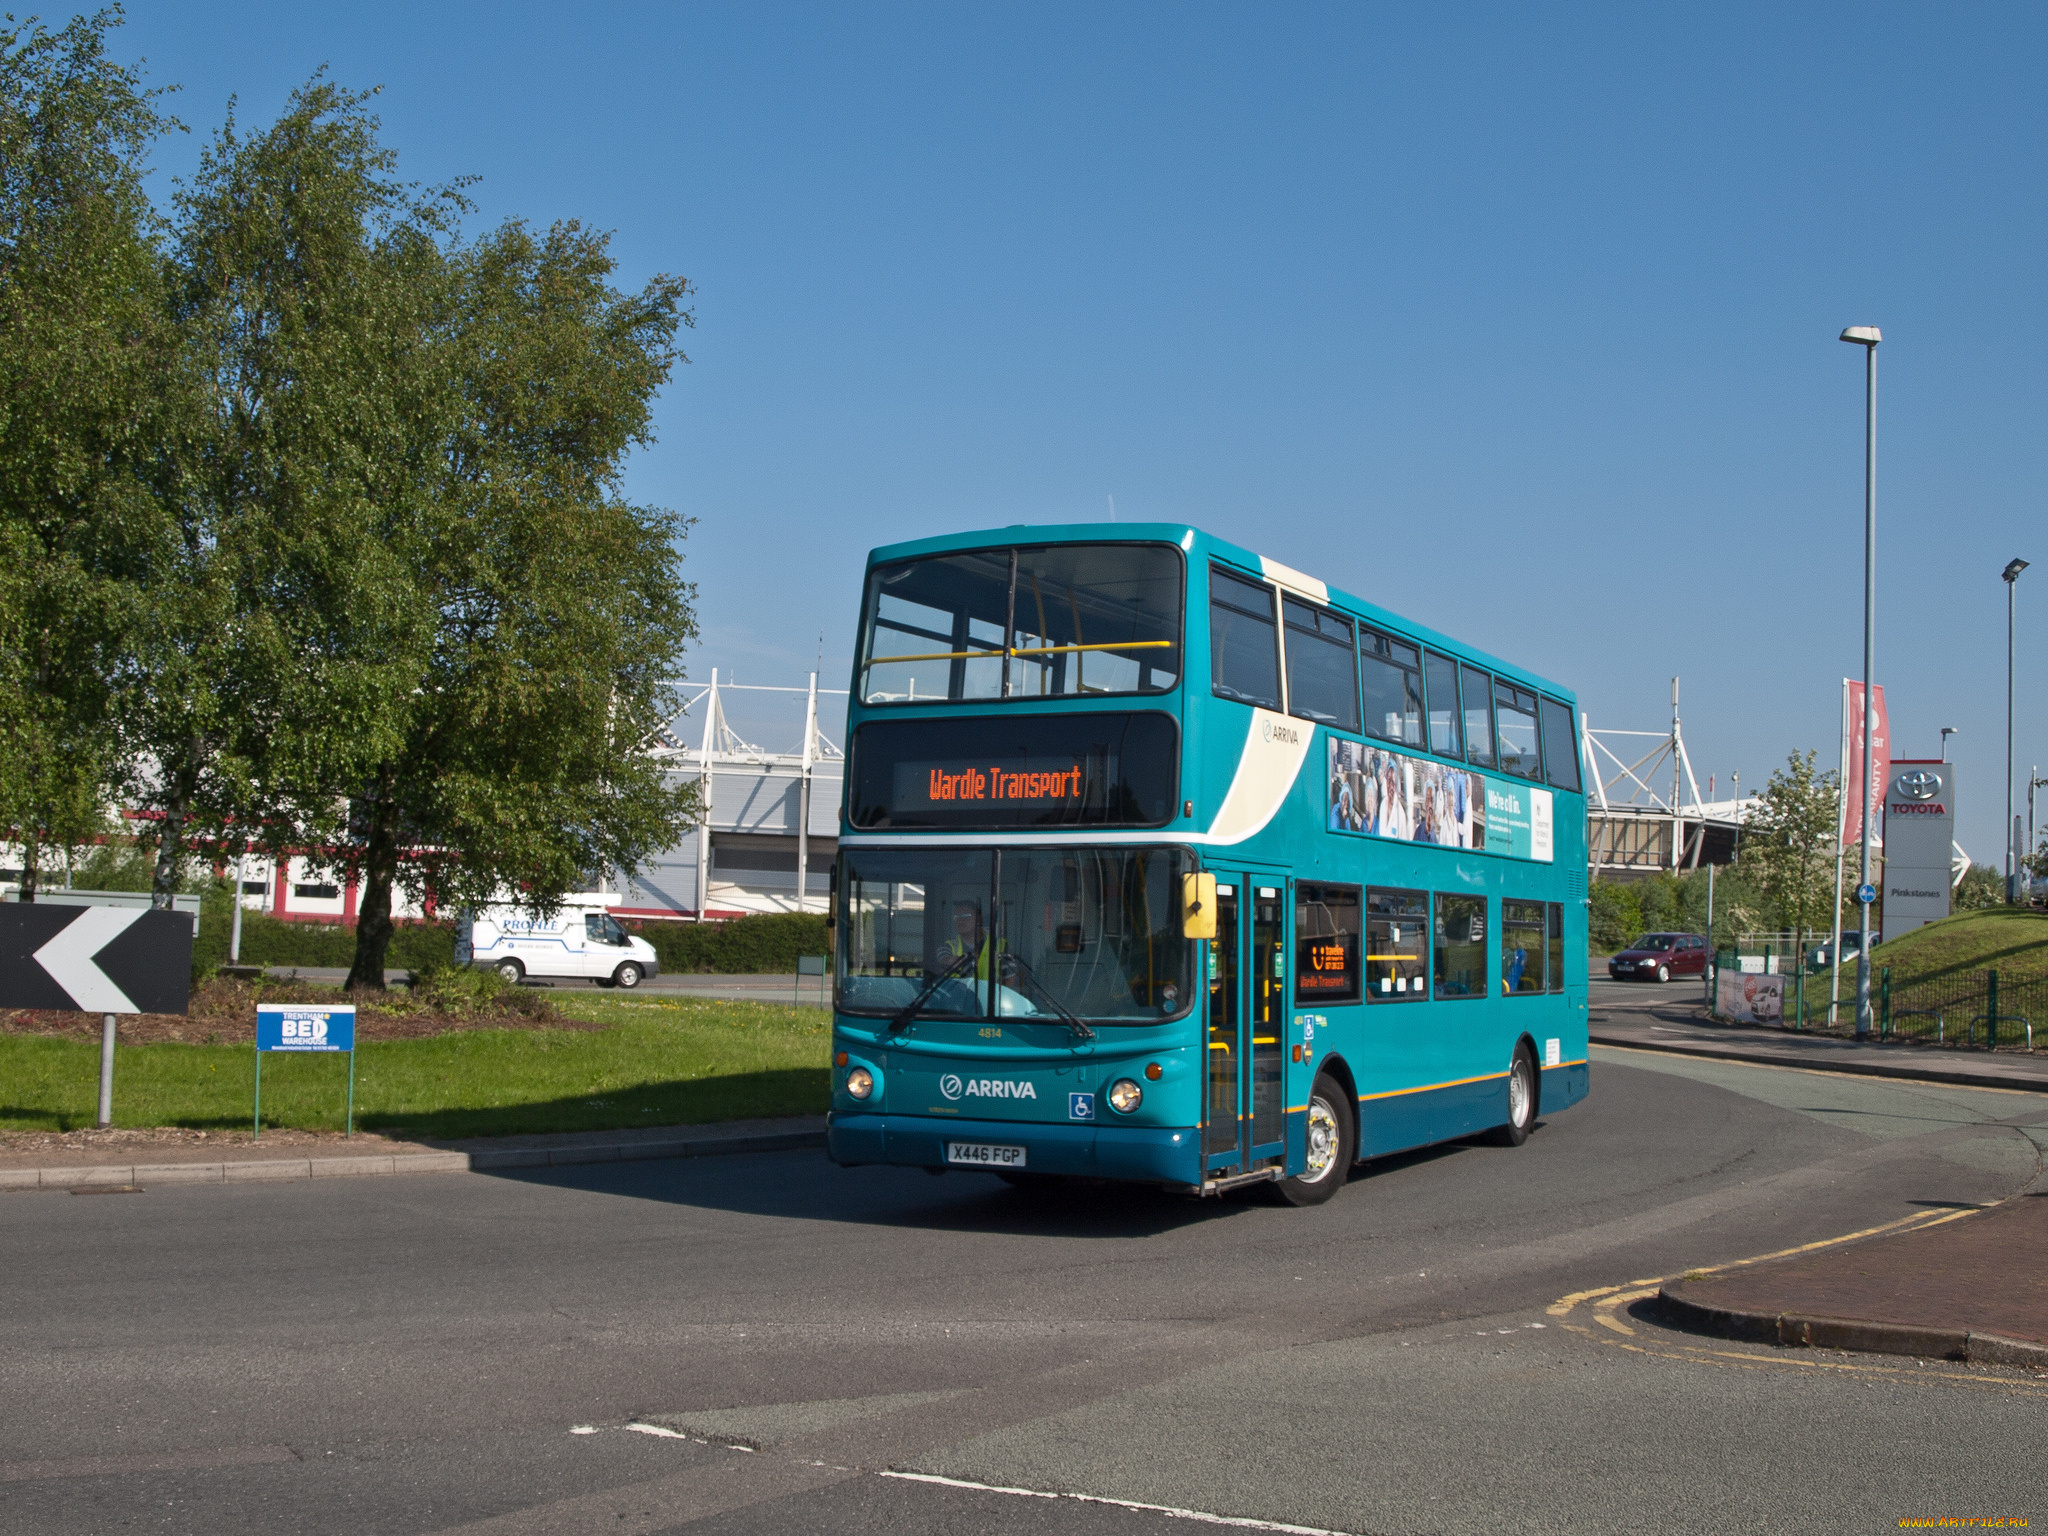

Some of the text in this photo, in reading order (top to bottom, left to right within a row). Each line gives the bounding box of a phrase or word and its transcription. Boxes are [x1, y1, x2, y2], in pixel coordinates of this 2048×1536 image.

[1273, 725, 1299, 746] ARRIVA
[1857, 733, 1884, 749] yar
[929, 765, 1082, 800] Wardle Transport
[1891, 803, 1947, 814] TOYOTA
[1891, 888, 1941, 898] Pinkstones
[282, 1020, 328, 1038] BED
[978, 1028, 1002, 1038] 4814
[282, 1037, 327, 1045] WAREHOUSE
[965, 1079, 1037, 1099] ARRIVA
[953, 1145, 1020, 1163] X446 FGP
